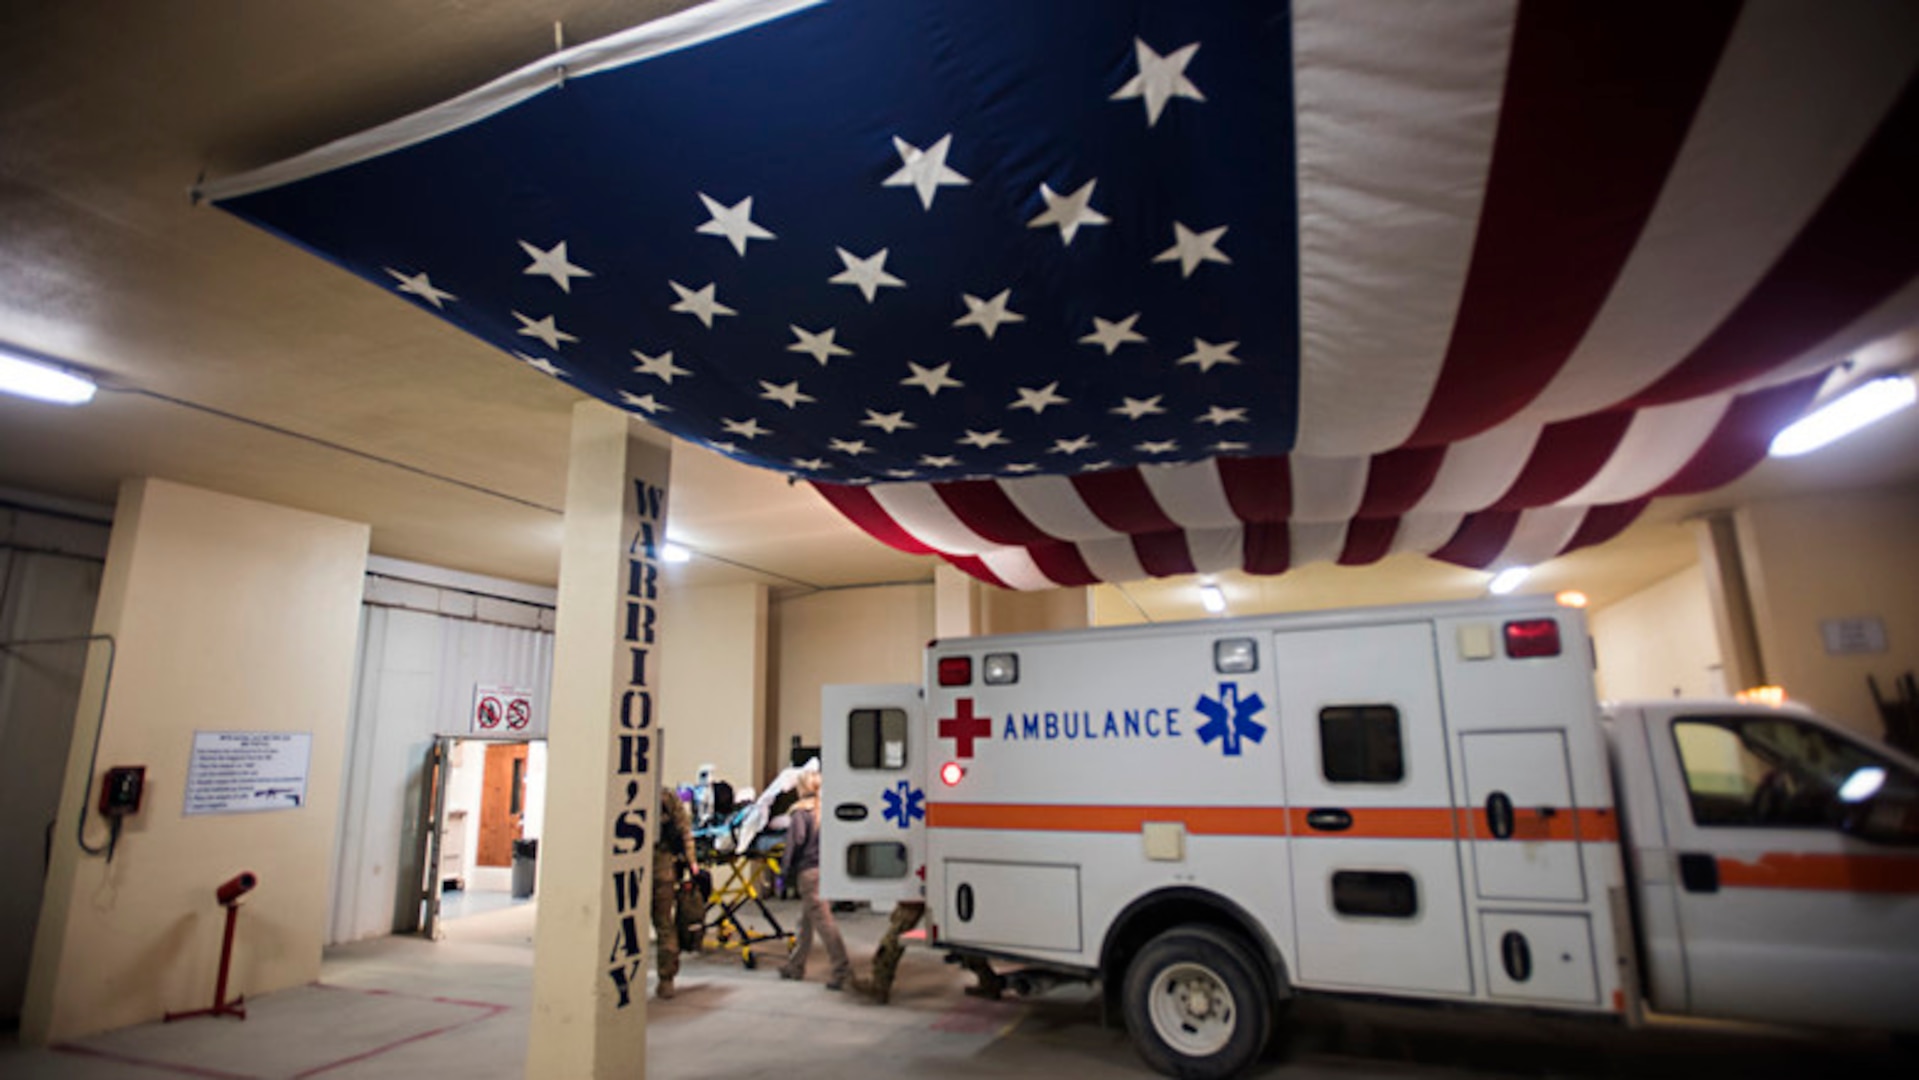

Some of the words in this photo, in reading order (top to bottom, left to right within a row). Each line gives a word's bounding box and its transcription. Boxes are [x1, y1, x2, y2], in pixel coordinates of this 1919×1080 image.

[613, 478, 663, 855] WARRIOR'S
[1003, 708, 1182, 740] AMBULANCE
[608, 866, 645, 1009] WAY
